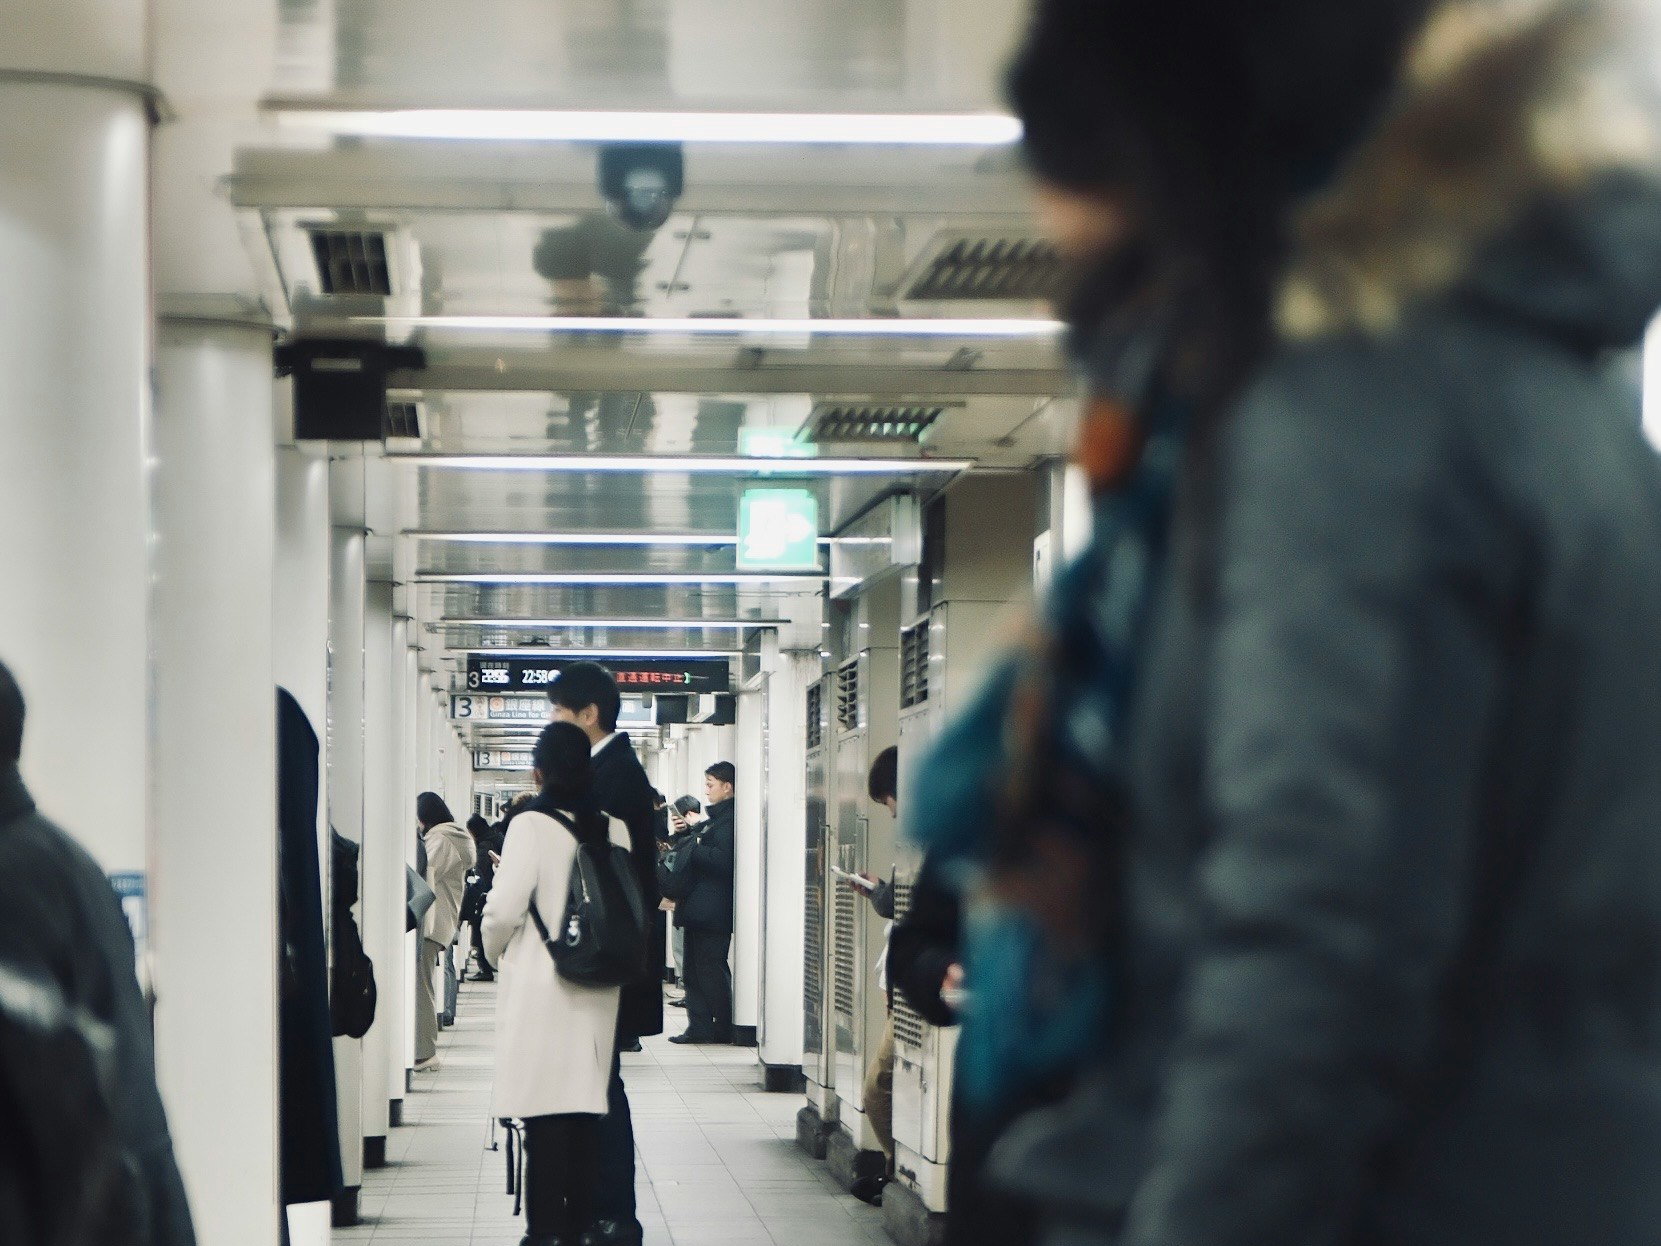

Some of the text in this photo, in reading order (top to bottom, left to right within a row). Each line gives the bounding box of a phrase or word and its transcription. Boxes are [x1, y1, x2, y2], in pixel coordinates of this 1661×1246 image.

[468, 671, 480, 688] 3
[521, 669, 548, 684] 22:58
[458, 697, 472, 717] 3
[481, 751, 490, 765] 3
